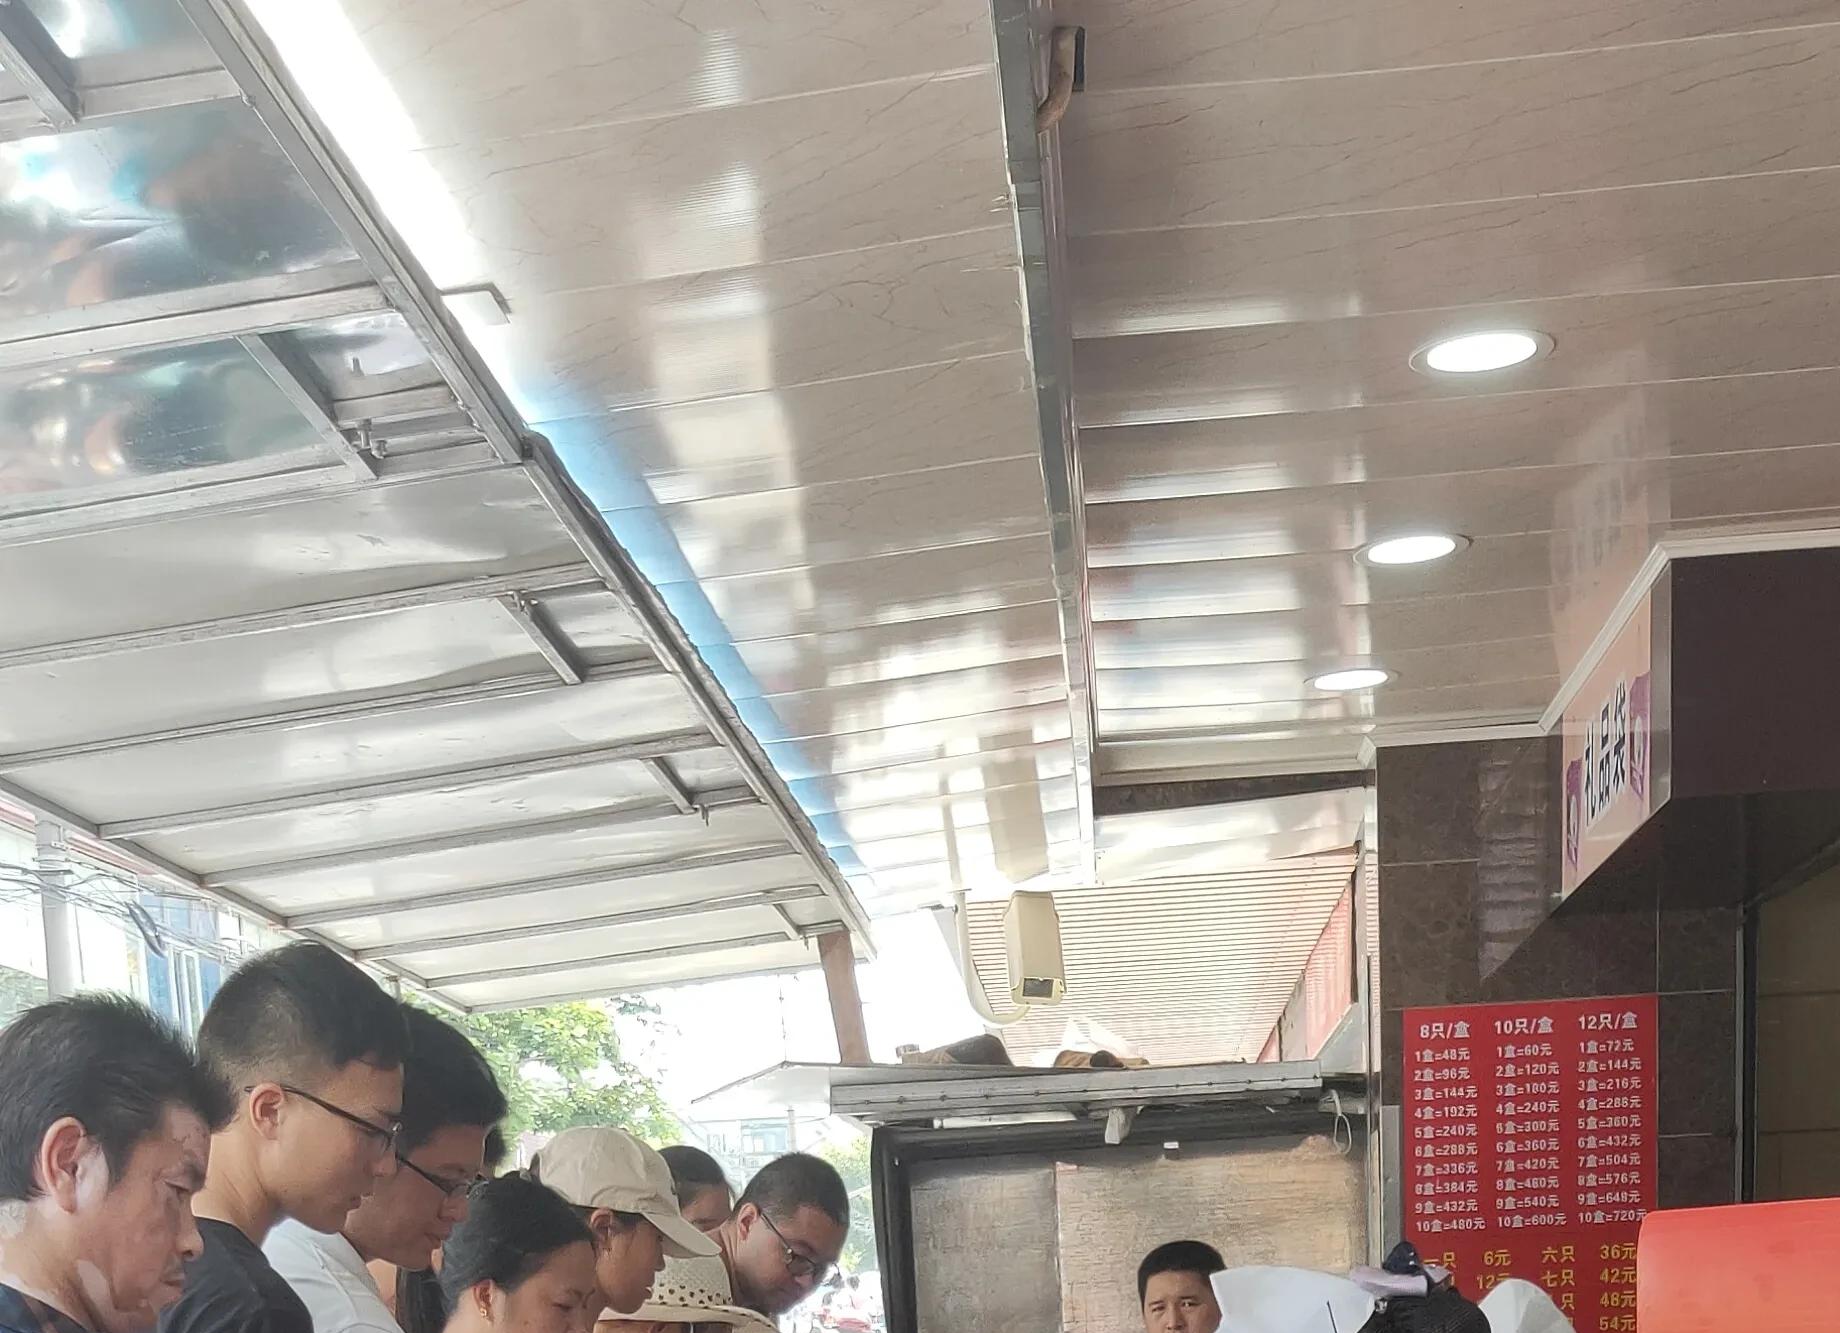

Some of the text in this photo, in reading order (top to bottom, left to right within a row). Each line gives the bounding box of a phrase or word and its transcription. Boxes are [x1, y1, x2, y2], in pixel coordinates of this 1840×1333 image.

[1420, 1021, 1470, 1039] 8只/盒
[1495, 1016, 1553, 1035] 10只/盒
[1579, 1011, 1637, 1030] 12只/盒
[1484, 1250, 1511, 1266] 6元
[1542, 1246, 1575, 1264] 六只
[1601, 1243, 1636, 1259] 36元
[1542, 1271, 1575, 1287] 七只
[1601, 1268, 1636, 1284] 42元
[1601, 1293, 1636, 1308] 48元
[1601, 1316, 1635, 1331] 54元
